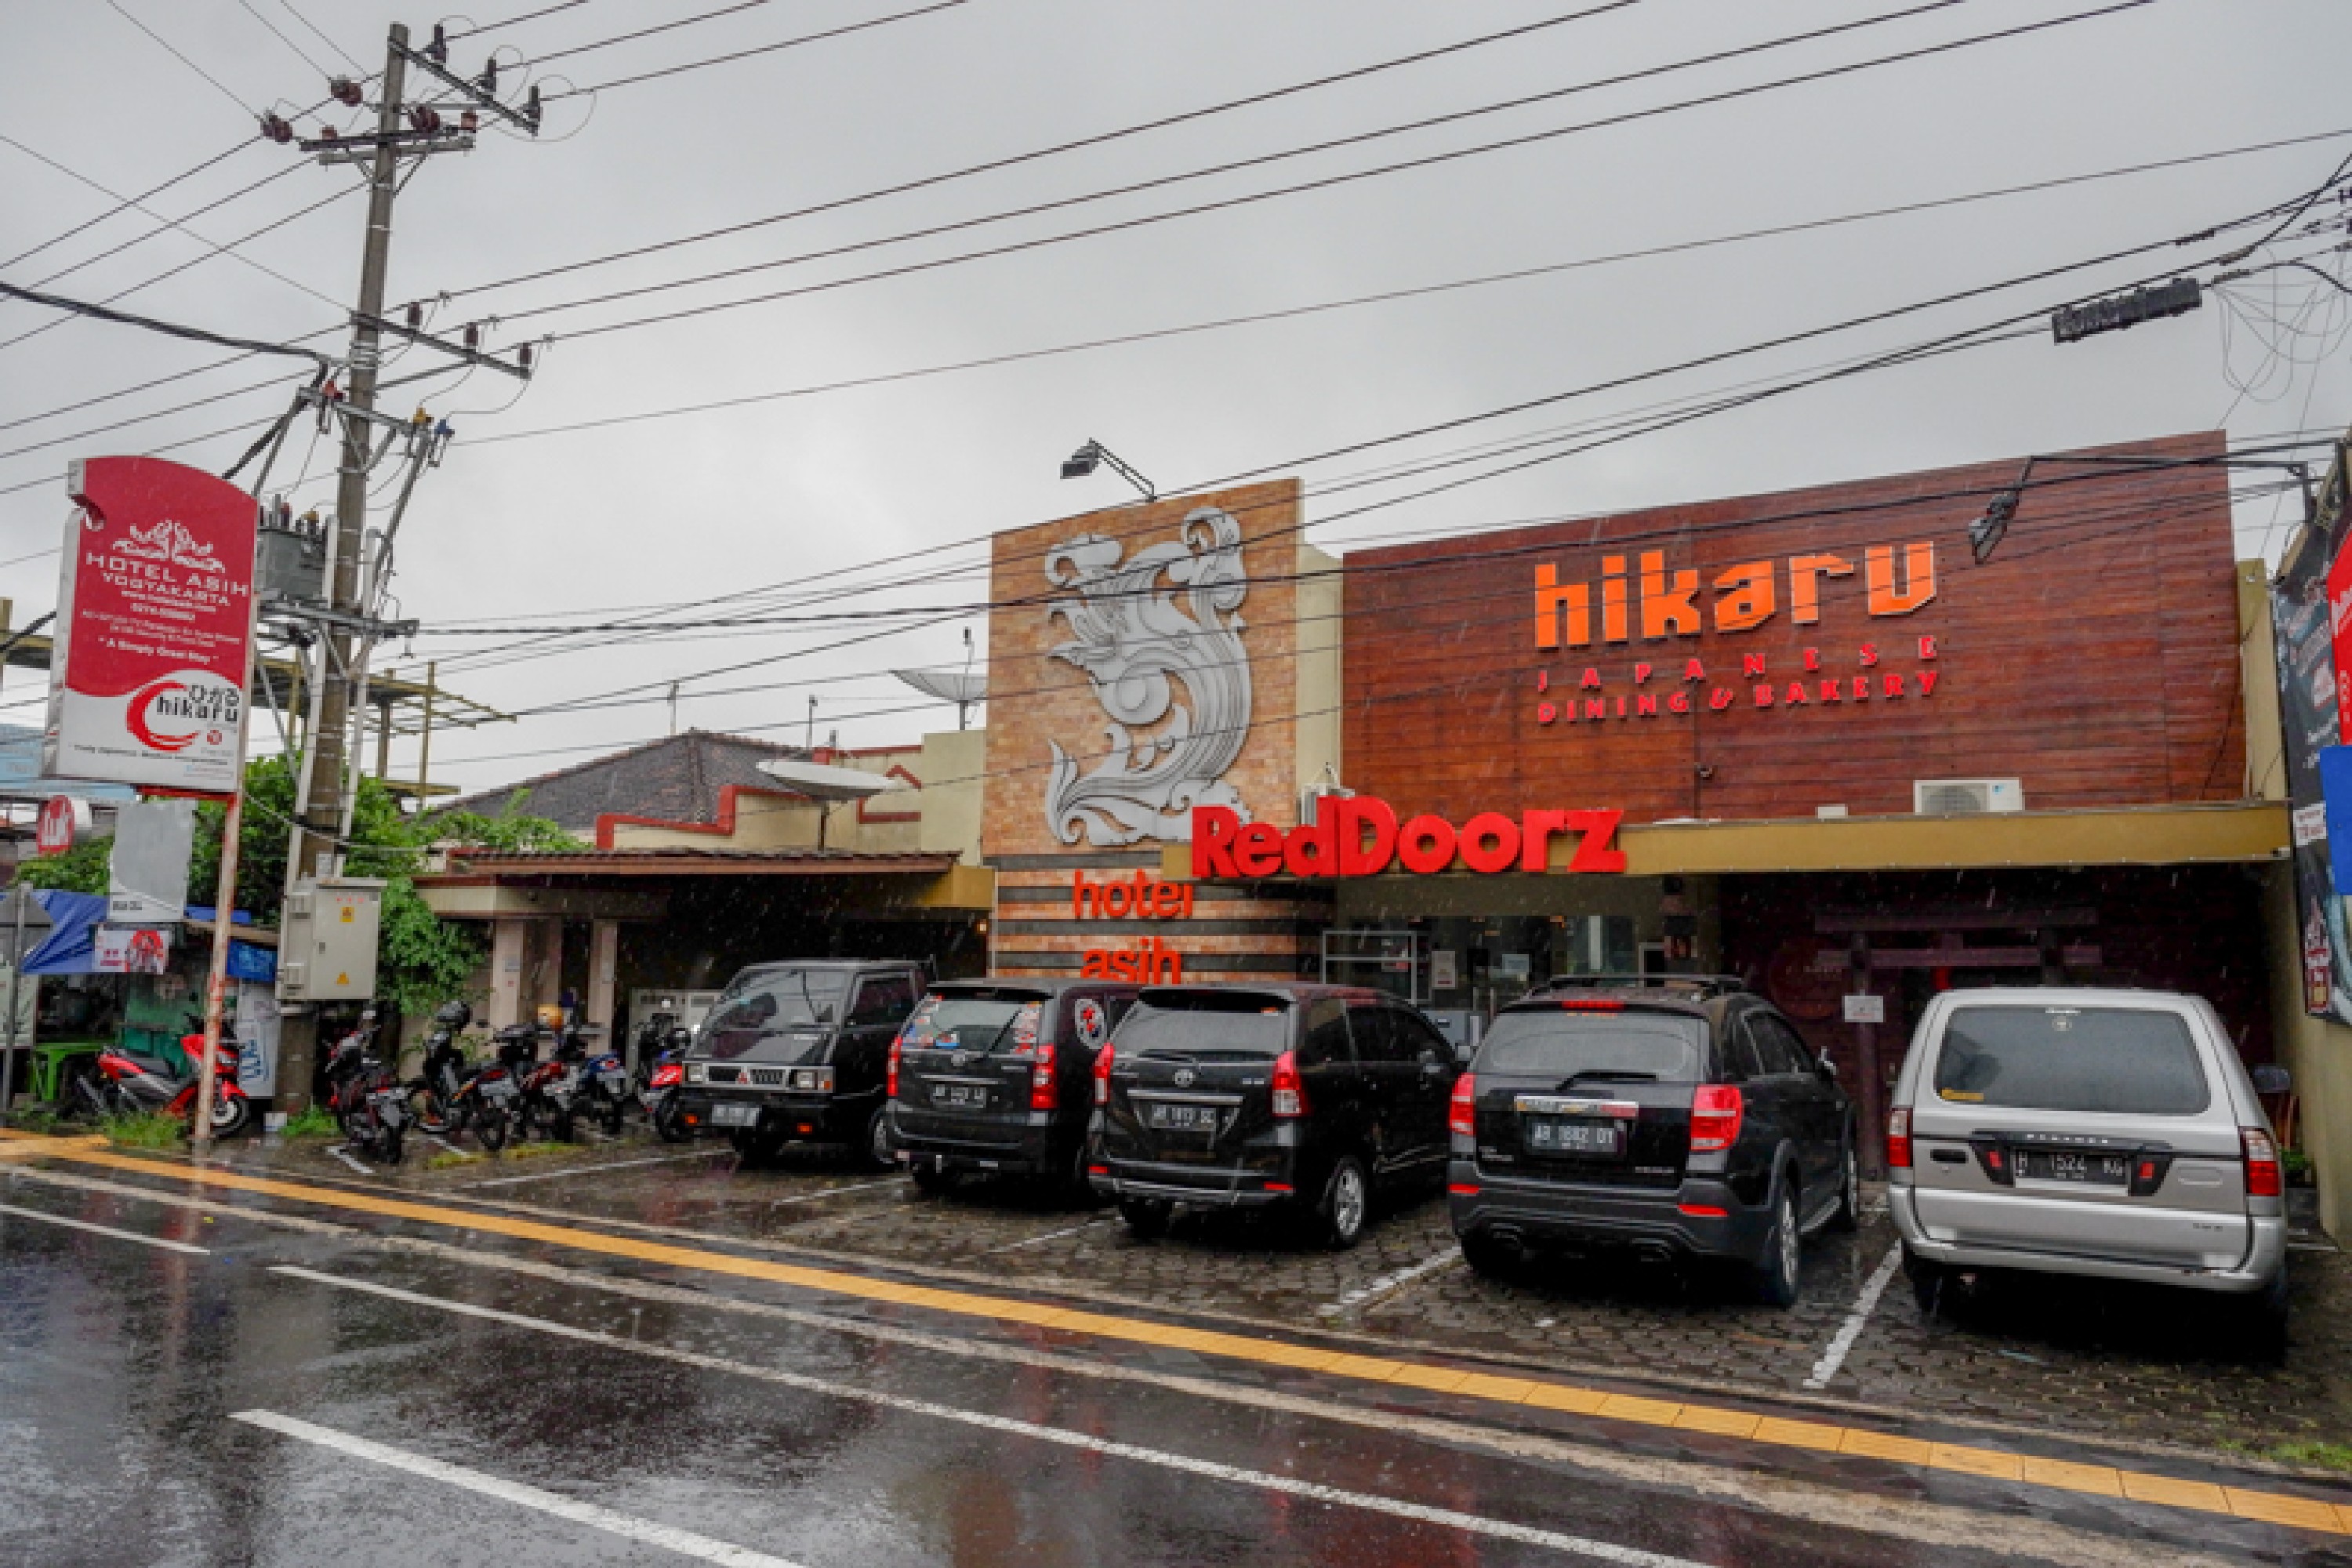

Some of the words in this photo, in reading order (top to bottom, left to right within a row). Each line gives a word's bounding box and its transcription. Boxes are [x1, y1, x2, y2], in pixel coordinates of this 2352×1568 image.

[86, 552, 177, 583] HOTEL
[186, 573, 249, 597] ASIH
[101, 571, 231, 607] YOGYAKARTA
[1534, 541, 1936, 648] hikaru
[1537, 635, 1938, 691] JAPANESE
[157, 695, 238, 722] hikaru
[1537, 691, 1687, 723] DINING
[1754, 670, 1937, 708] BAKERY
[1192, 795, 1626, 879] RedDoorz
[1073, 869, 1193, 919] hotel
[1081, 936, 1182, 983] asih
